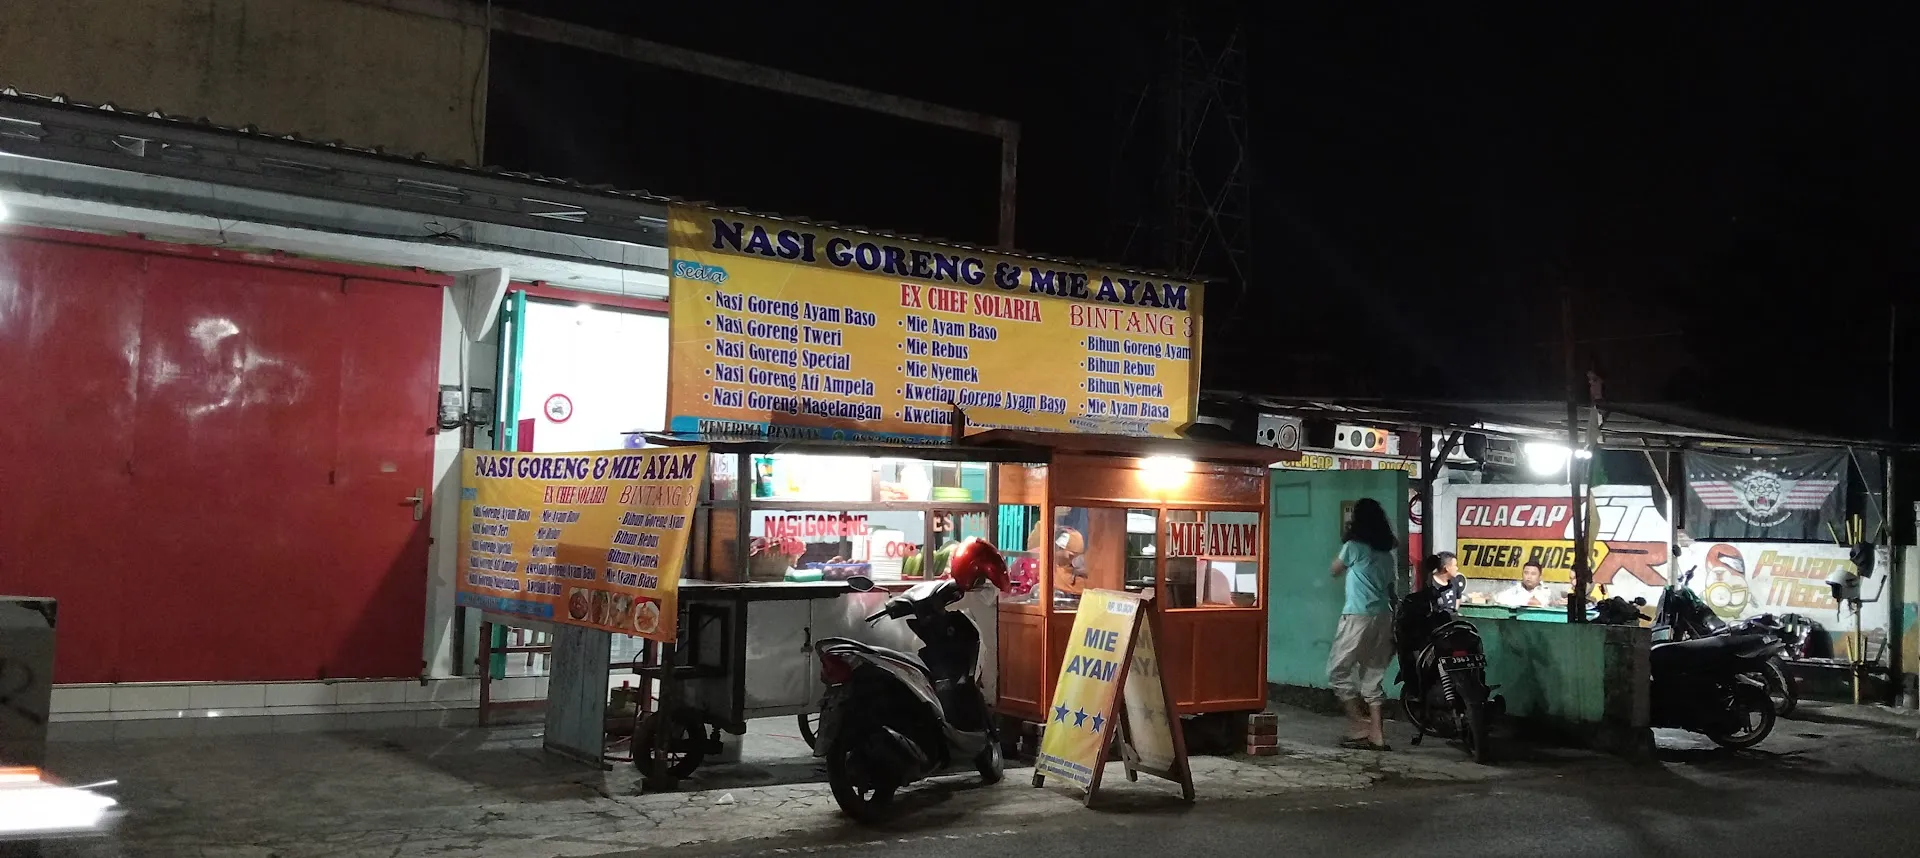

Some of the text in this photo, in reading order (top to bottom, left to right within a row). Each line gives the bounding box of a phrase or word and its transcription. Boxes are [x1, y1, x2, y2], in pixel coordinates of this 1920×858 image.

[674, 262, 727, 284] Sedia
[711, 218, 1187, 310] NASI GORENG & MIE AYAM
[716, 290, 876, 326] Nasi Goreng Ayam Baso
[901, 284, 1193, 338] EX CHEF SOLARIA BINTANG 3
[716, 313, 842, 346] Nasi Goreng Tweri
[907, 315, 997, 341] Mie Ayam Baso
[716, 338, 850, 371] Nasi Goreng Special
[907, 338, 968, 359] Mie Rebus
[1087, 336, 1191, 361] Bihun Goreng Ayam
[715, 363, 874, 396] Nasi Goreng Ati Ampela
[906, 361, 978, 383] Mie Nyemek
[1087, 357, 1155, 377] Bihun Rebus
[905, 383, 955, 403] Kwetiau
[959, 388, 1001, 408] Goreng
[1040, 395, 1066, 414] Baso
[1087, 378, 1163, 398] Bihun Nyemek
[713, 387, 881, 421] Nasi Goreng Magelangan
[1087, 399, 1169, 419] Mie Ayam Biasa
[475, 455, 514, 478] NASI
[517, 456, 589, 480] GORENG
[592, 457, 608, 479] &
[608, 456, 643, 480] MIE
[643, 453, 697, 480] AYAM
[556, 486, 575, 504] CHEF
[577, 486, 608, 504] SOLARIA
[619, 485, 682, 506] BINTANG
[685, 485, 694, 506] 3
[622, 511, 644, 526] Bihun
[645, 514, 668, 529] Goreng
[805, 515, 868, 536] GORENG
[933, 511, 955, 532] ES
[1460, 505, 1567, 528] CILACAP
[613, 530, 638, 545] Bihun
[1170, 522, 1257, 557] MIE AYAM
[607, 548, 659, 569] Bihun Nyemek
[1462, 544, 1599, 569] TIGER RIDES
[637, 572, 658, 589] Biasa
[1083, 627, 1119, 652] MIE
[1066, 655, 1118, 682] AYAM
